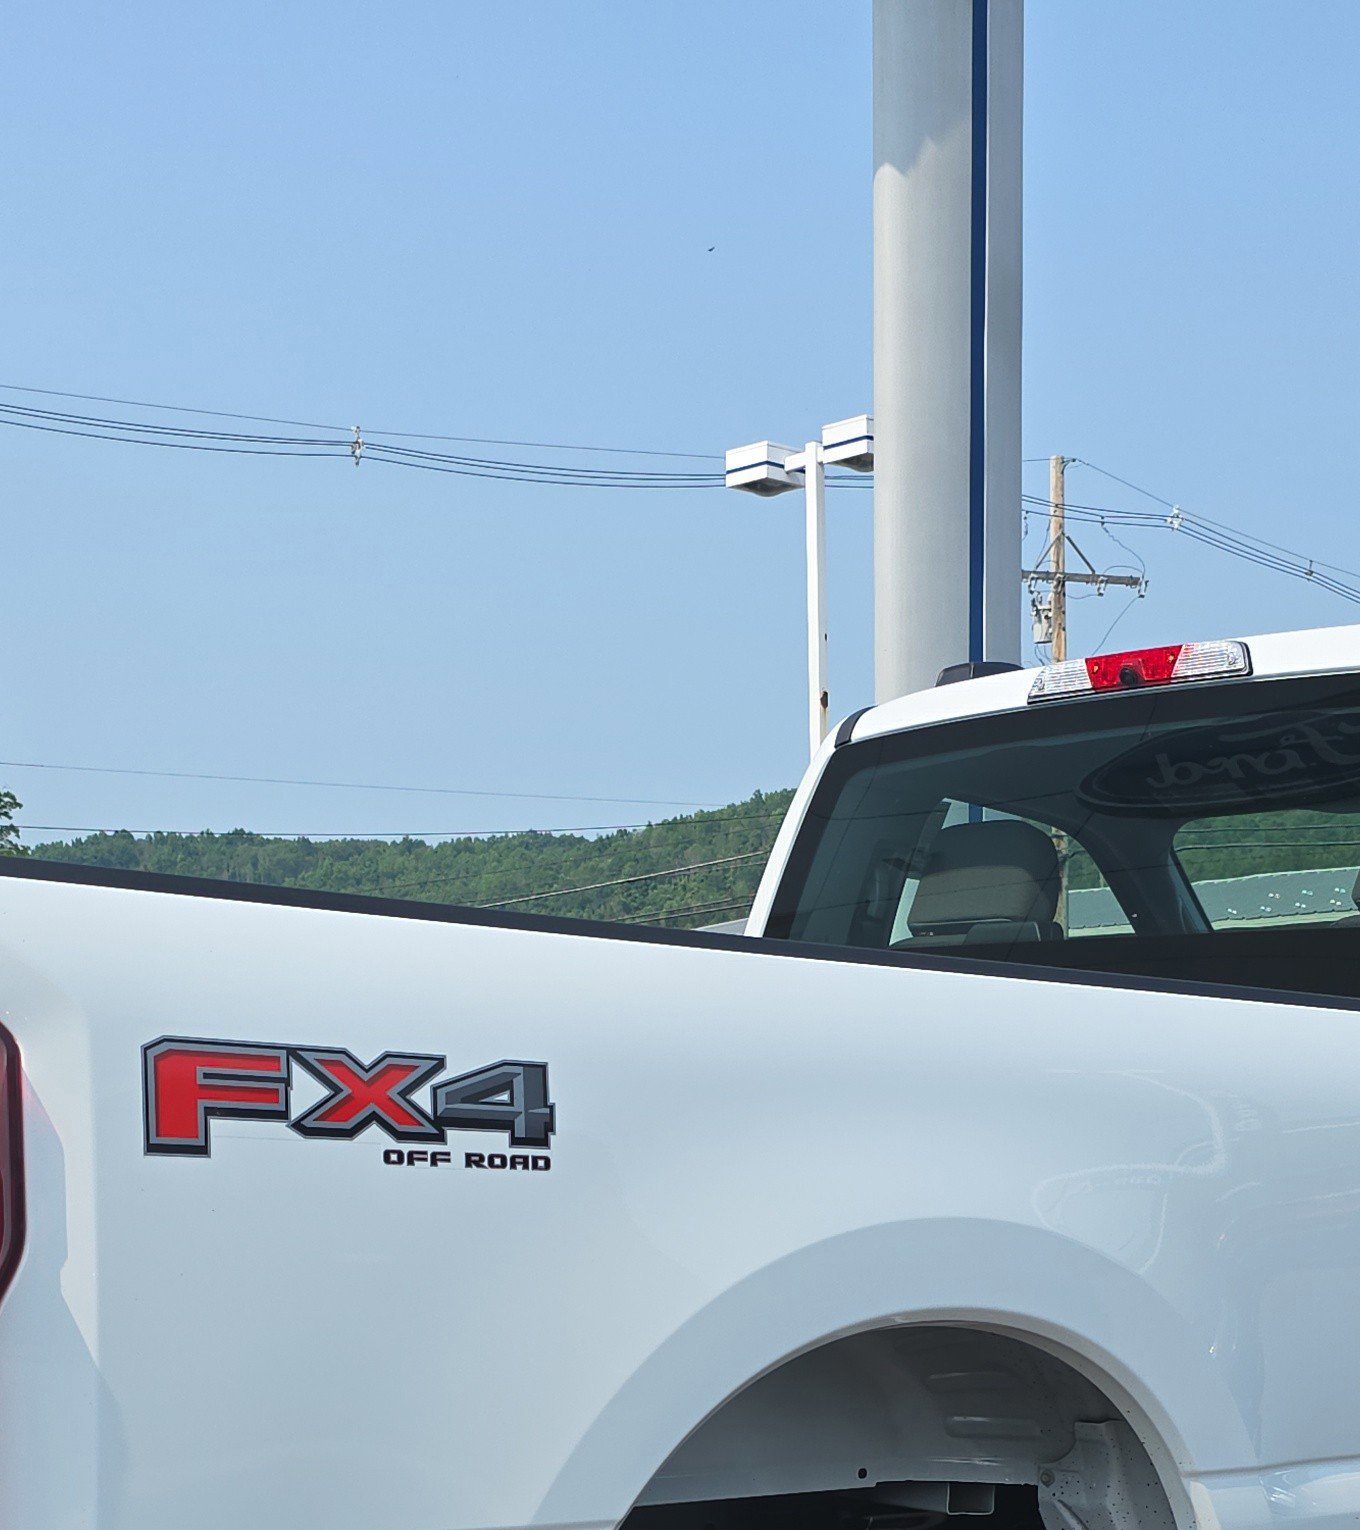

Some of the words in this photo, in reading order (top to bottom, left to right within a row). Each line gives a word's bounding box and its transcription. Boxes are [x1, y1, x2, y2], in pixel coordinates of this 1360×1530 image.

[140, 1035, 556, 1158] FX4
[383, 1149, 451, 1167] OFF
[465, 1152, 551, 1171] ROAD
